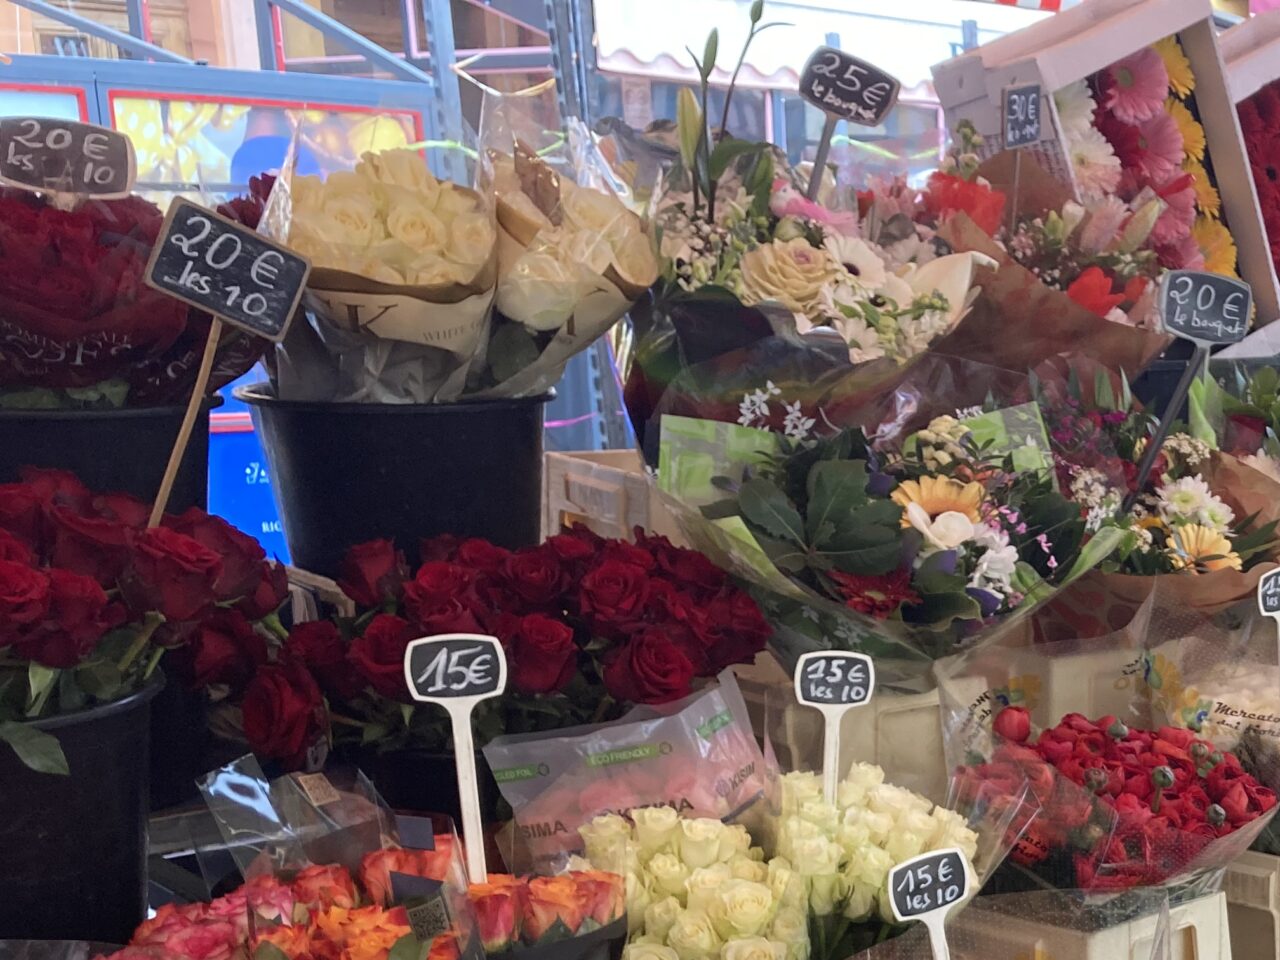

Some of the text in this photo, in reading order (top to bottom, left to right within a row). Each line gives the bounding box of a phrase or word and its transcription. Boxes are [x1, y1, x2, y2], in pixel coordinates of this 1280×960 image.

[7, 142, 115, 184] les 10
[224, 285, 267, 316] 10
[1191, 310, 1244, 336] bouquet
[417, 645, 492, 692] 15€
[810, 682, 866, 702] les 10
[906, 885, 959, 910] les 10
